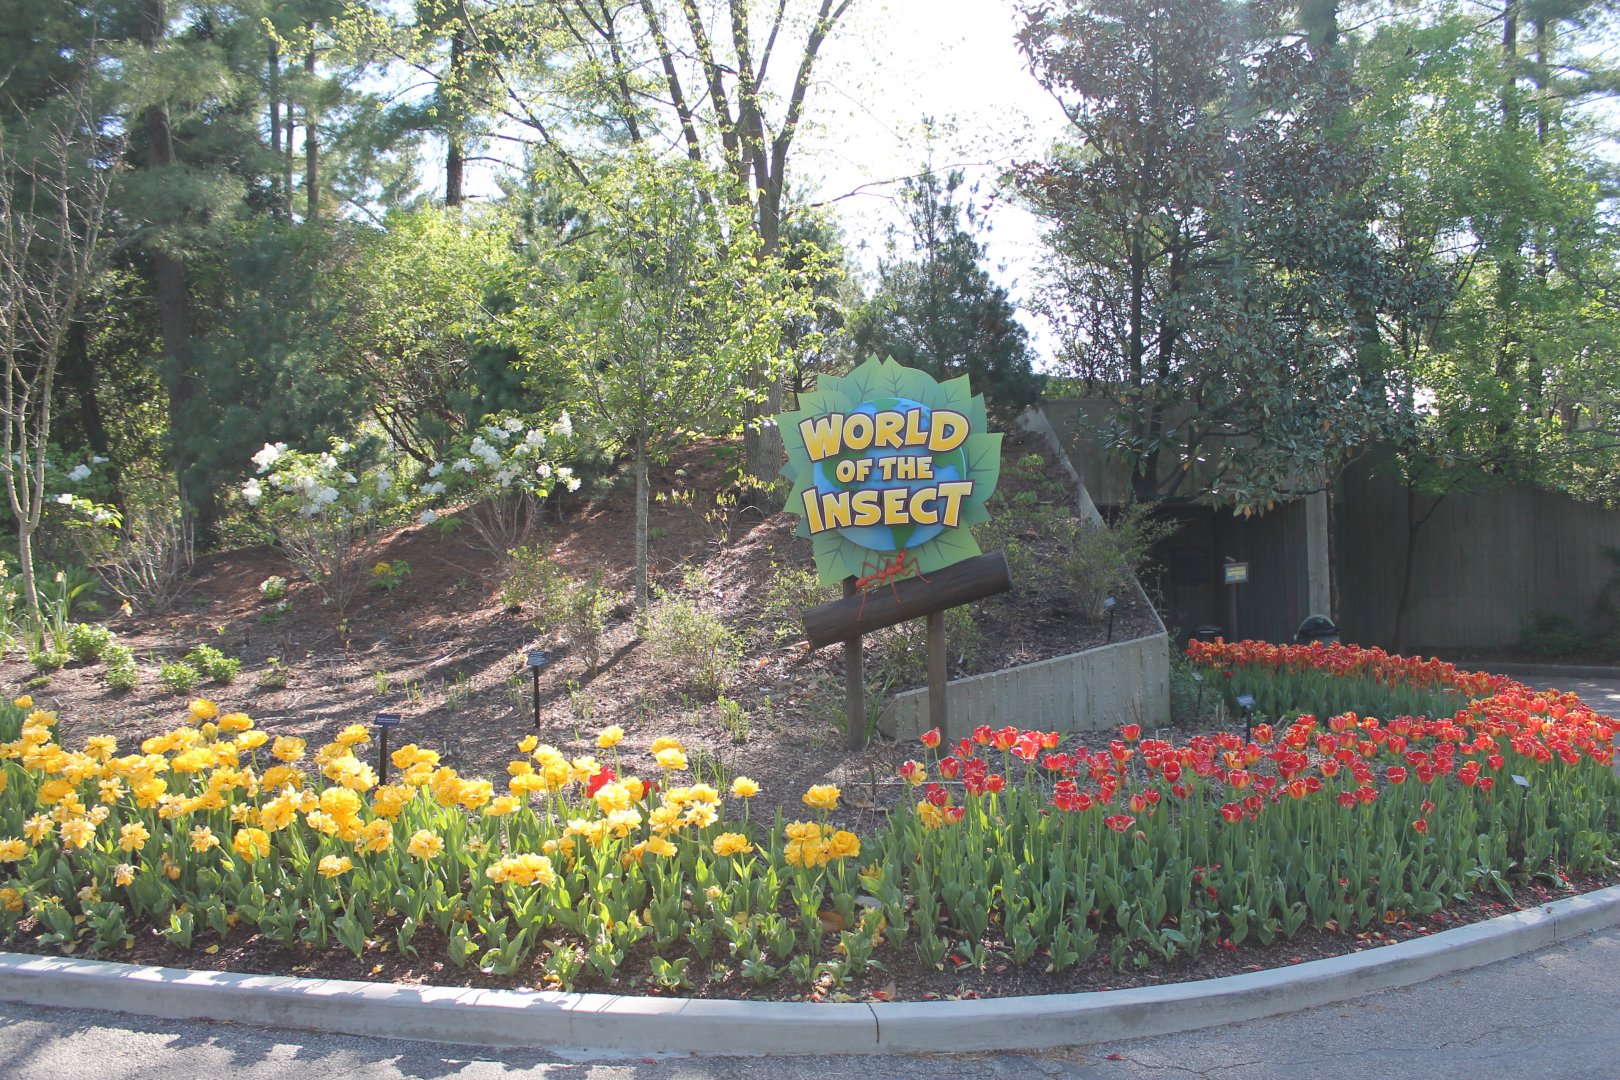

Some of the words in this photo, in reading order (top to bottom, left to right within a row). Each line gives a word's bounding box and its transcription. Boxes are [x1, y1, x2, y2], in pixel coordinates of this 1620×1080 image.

[799, 408, 970, 461] WORLD
[836, 458, 872, 482] OF
[879, 457, 933, 481] THE
[802, 480, 973, 534] INSECT
